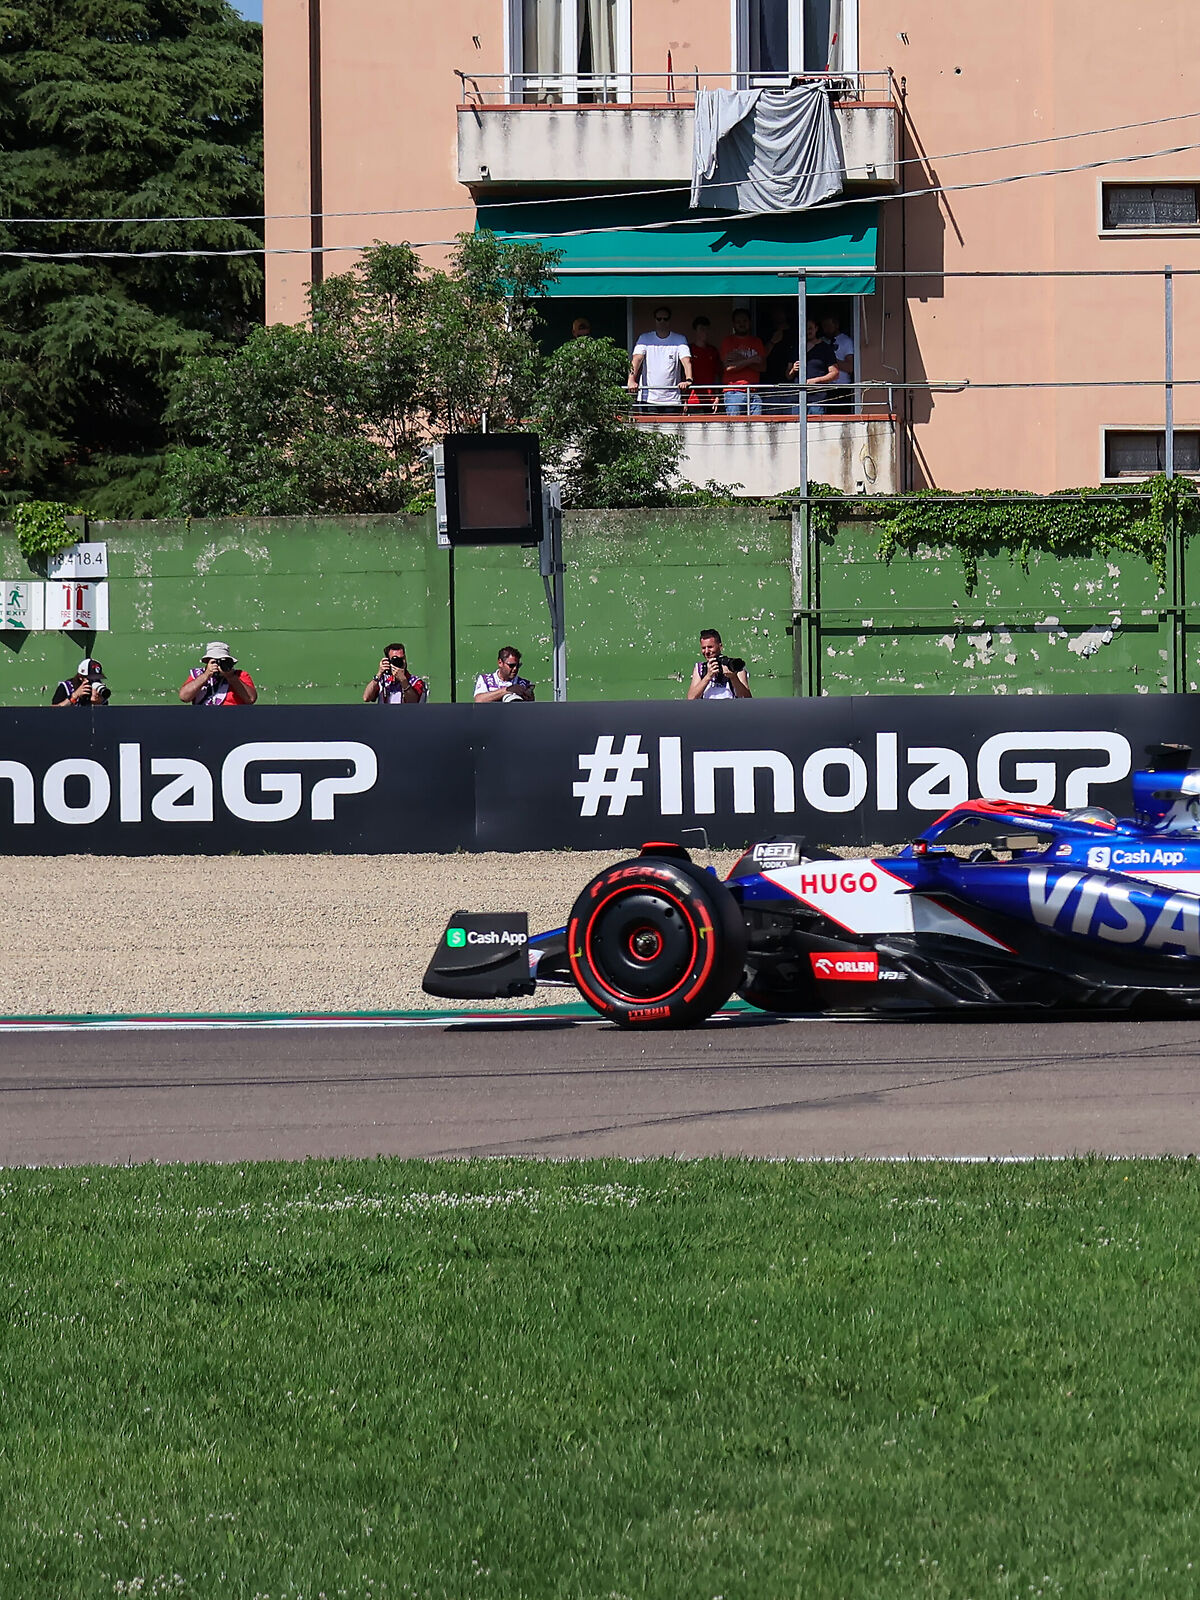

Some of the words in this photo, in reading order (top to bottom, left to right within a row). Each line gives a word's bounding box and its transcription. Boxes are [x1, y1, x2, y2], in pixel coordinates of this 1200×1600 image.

[76, 552, 103, 565] 18.4
[573, 731, 1131, 817] #ImolaGP
[757, 845, 792, 858] NEFT
[1112, 850, 1150, 864] Cash
[1152, 849, 1184, 866] App
[801, 872, 878, 894] HUGO
[467, 931, 499, 944] Cash
[501, 930, 527, 946] App
[835, 961, 875, 973] ORLEN
